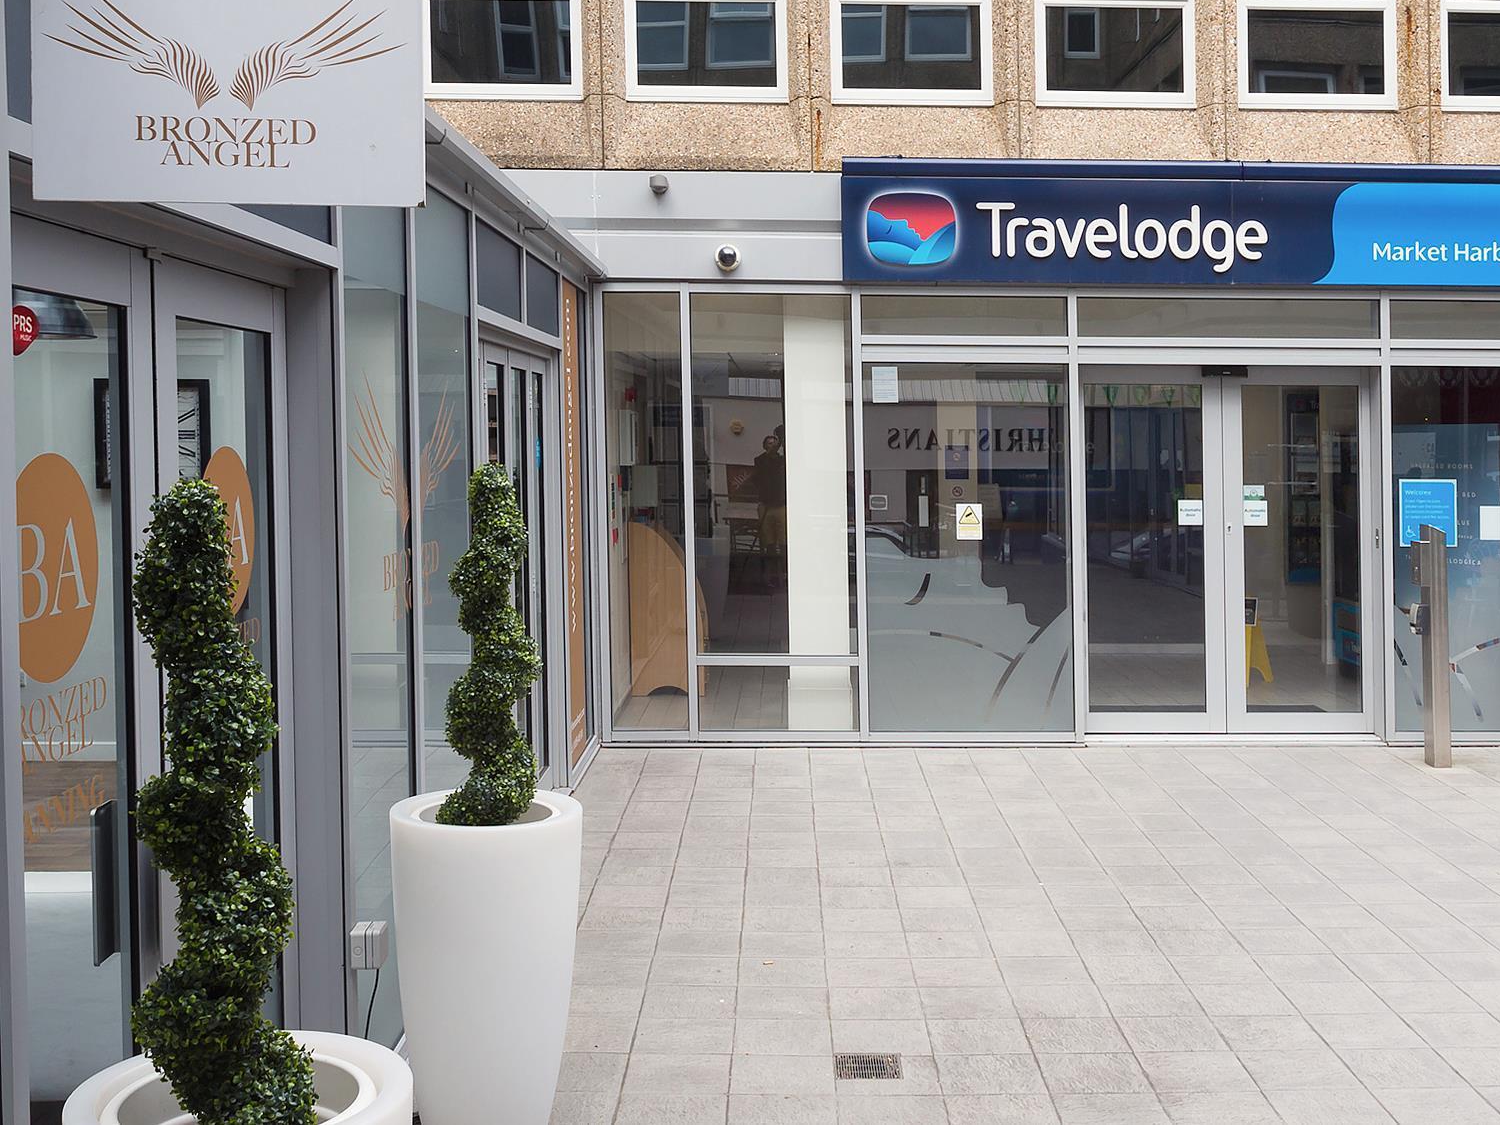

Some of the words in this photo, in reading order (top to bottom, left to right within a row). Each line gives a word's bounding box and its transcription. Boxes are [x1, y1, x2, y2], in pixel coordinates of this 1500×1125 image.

[135, 115, 317, 145] BRONZED
[160, 139, 291, 168] ANGEL
[976, 202, 1268, 273] Travelodge
[1372, 241, 1448, 262] Market
[13, 314, 32, 333] PRS
[17, 517, 91, 624] BA
[20, 676, 107, 740] RONZED
